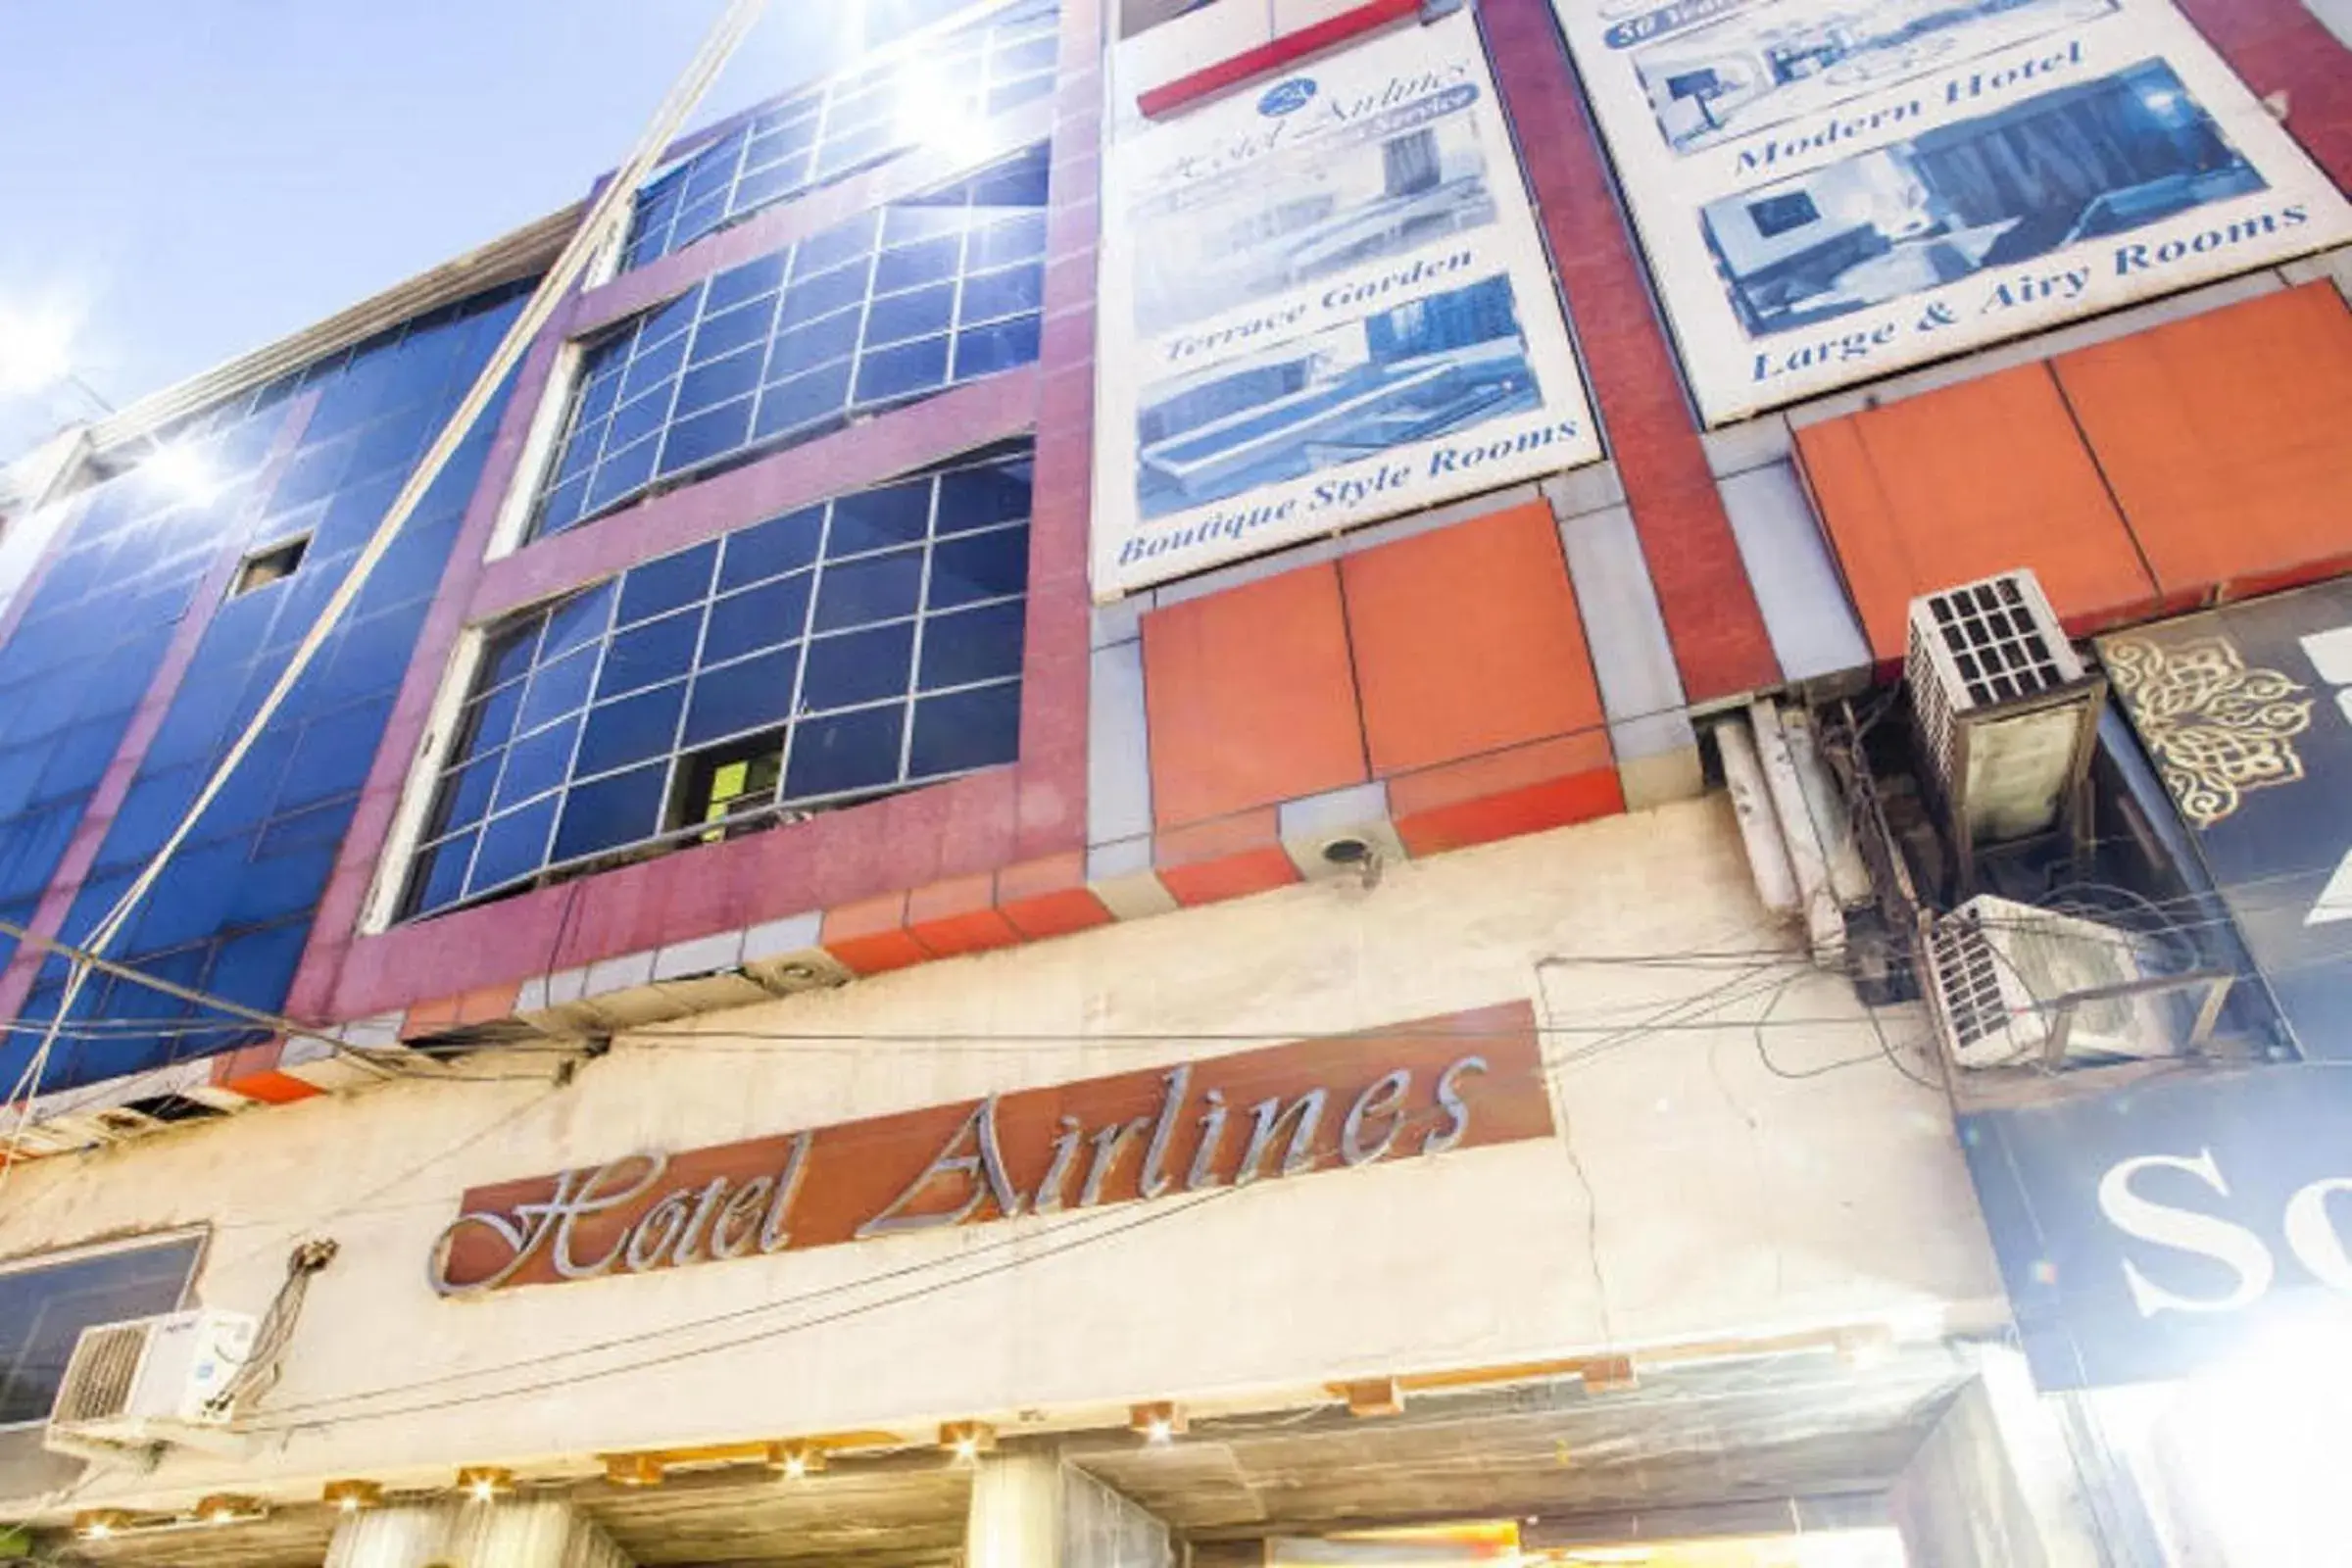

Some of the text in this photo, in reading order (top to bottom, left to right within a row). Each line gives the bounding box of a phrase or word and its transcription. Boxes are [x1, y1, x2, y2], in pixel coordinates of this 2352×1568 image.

[1734, 39, 2081, 176] Modern Hotel
[1169, 250, 1472, 361] Terrace Garden
[1751, 202, 2310, 383] Large & Airy Rooms
[1117, 419, 1580, 566] Boutique Style Rooms
[427, 1054, 1490, 1298] Hotel Airlines
